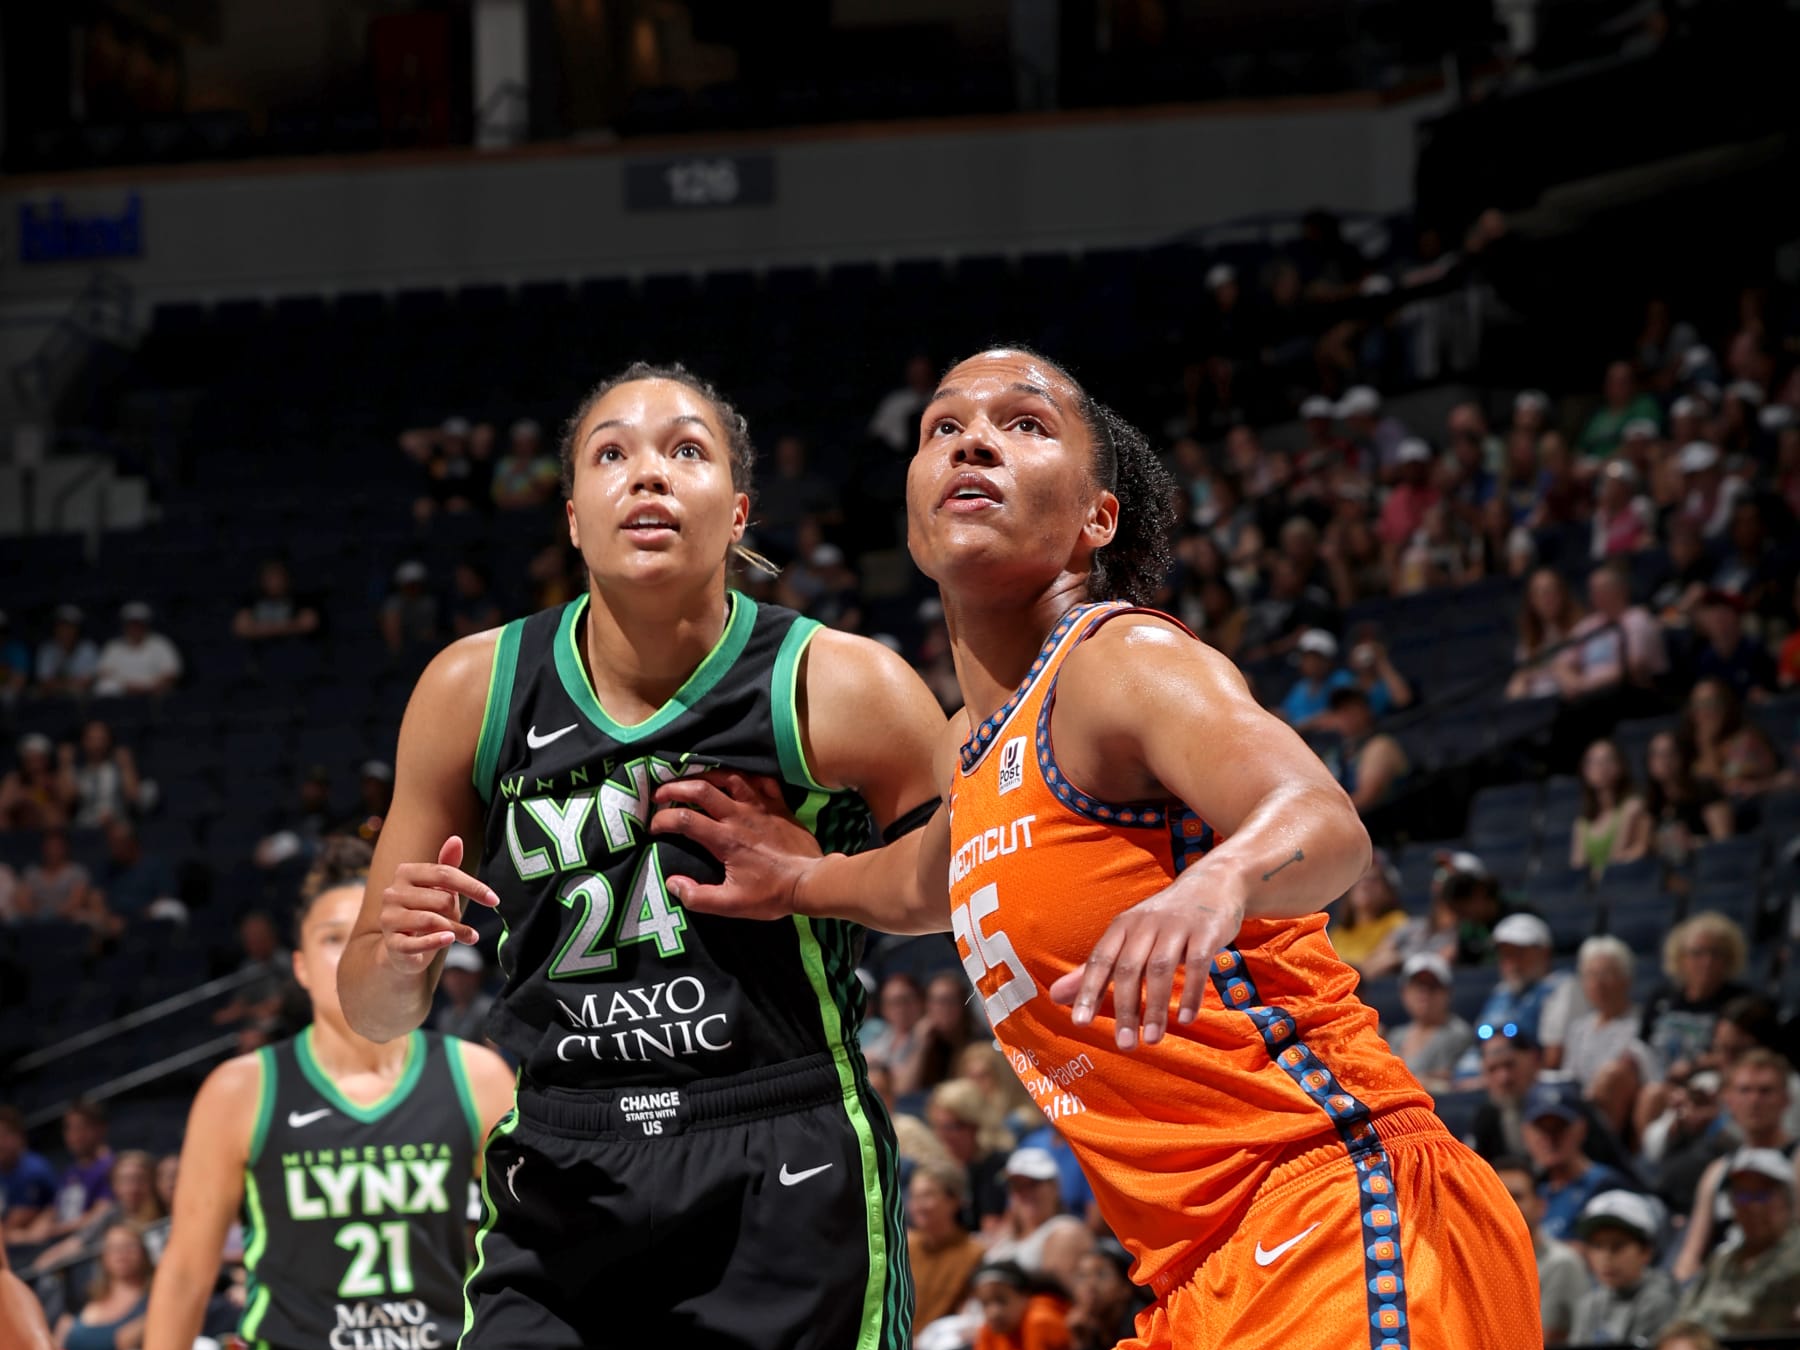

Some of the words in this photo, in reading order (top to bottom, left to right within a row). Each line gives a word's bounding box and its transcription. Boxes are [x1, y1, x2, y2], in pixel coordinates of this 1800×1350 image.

[949, 814, 1036, 893] NECTICUT
[549, 842, 688, 980] 24
[556, 975, 706, 1028] MAYO
[556, 1013, 732, 1062] CLINIC
[620, 1091, 681, 1112] CHANGE
[625, 1111, 655, 1122] STARTS
[655, 1108, 677, 1119] WITH
[642, 1120, 664, 1136] US
[282, 1143, 451, 1167] MINNESOTA
[284, 1158, 451, 1221] LYNX
[334, 1220, 414, 1298] 21
[334, 1299, 427, 1329] MAYO
